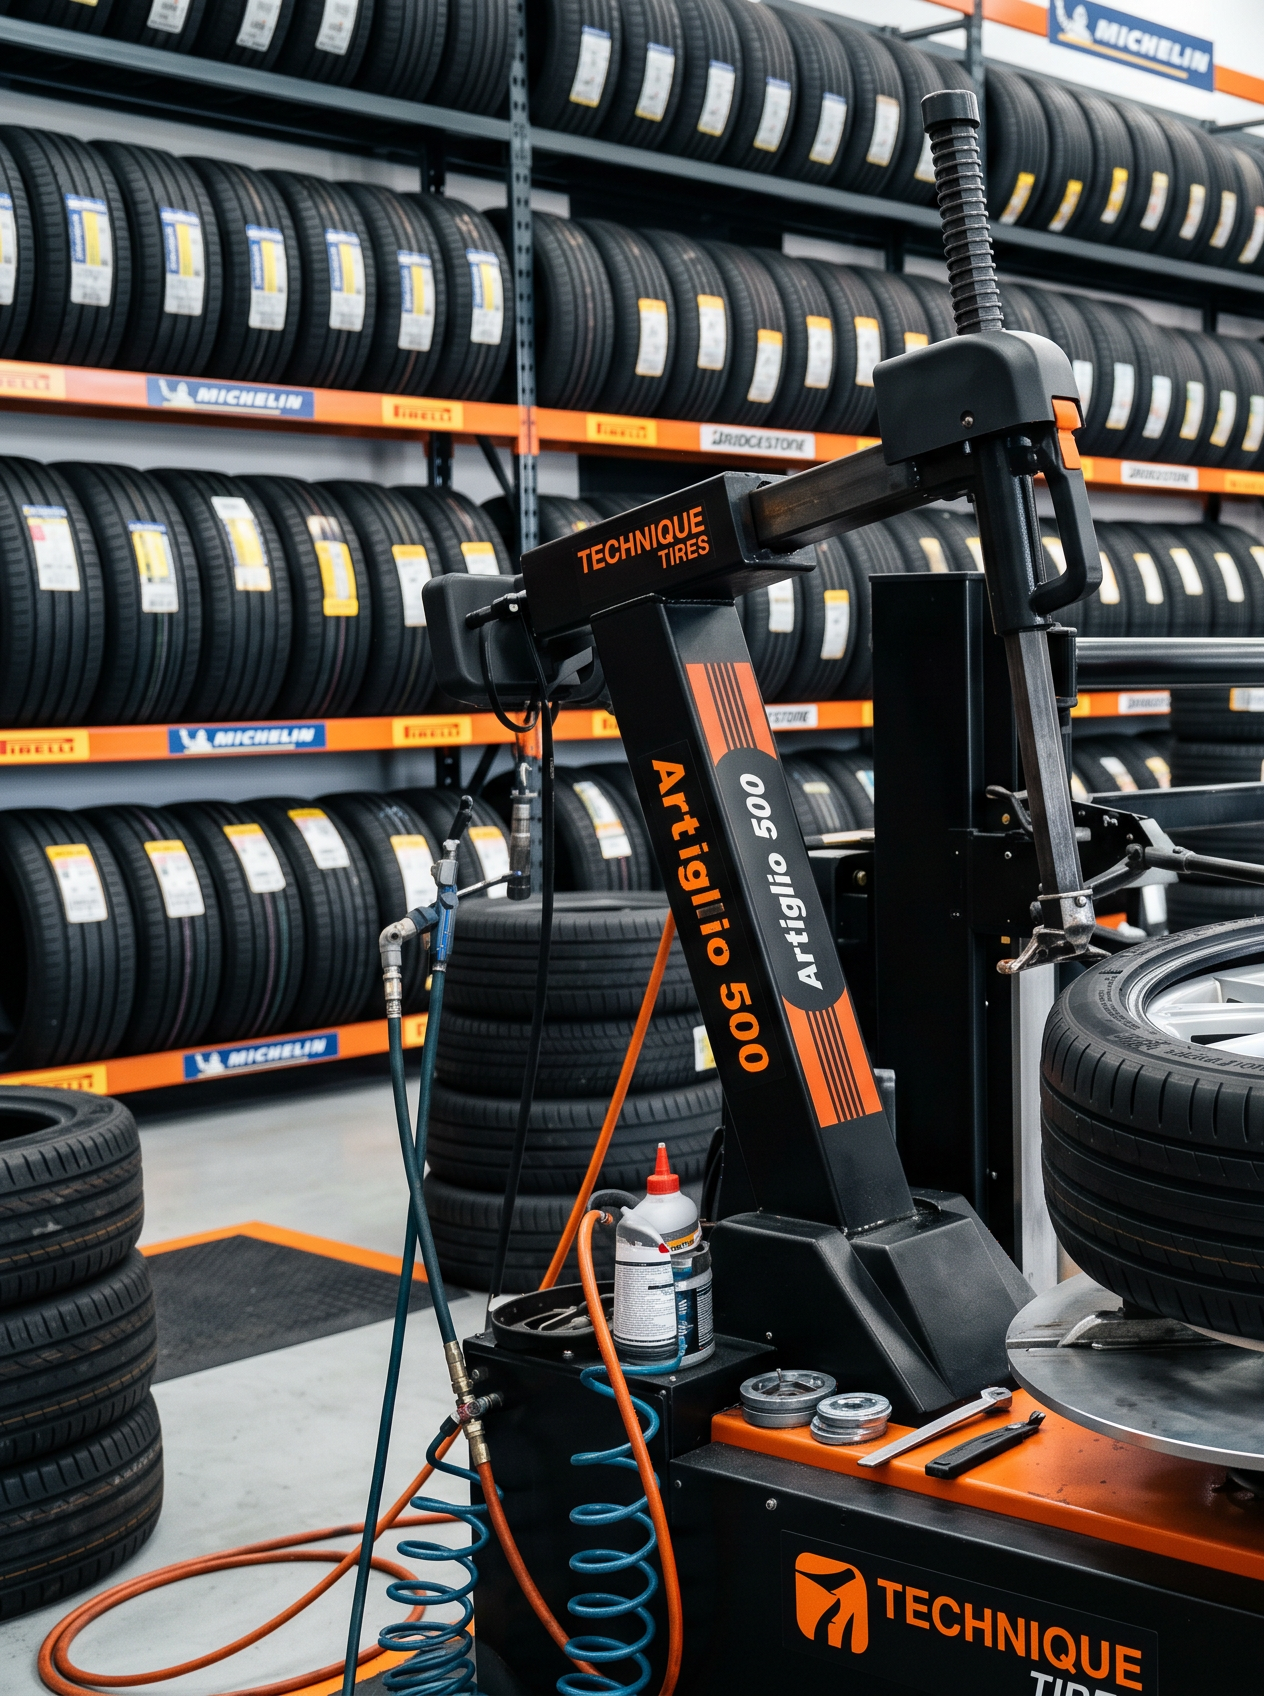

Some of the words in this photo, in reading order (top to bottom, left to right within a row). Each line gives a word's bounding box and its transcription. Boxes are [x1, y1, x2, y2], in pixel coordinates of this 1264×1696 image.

[1094, 18, 1211, 74] MICHELIN
[196, 387, 303, 410] MICHELIN
[393, 404, 452, 422] PIRELLI
[577, 506, 705, 574] TECHNIQUE
[657, 535, 710, 569] TIRES
[213, 726, 315, 747] MICHELIN
[740, 773, 778, 840] 500
[767, 852, 824, 990] Artiglio
[227, 1037, 328, 1068] MICHELIN
[720, 982, 770, 1073] 500
[877, 1577, 1144, 1692] TECHNIQUE
